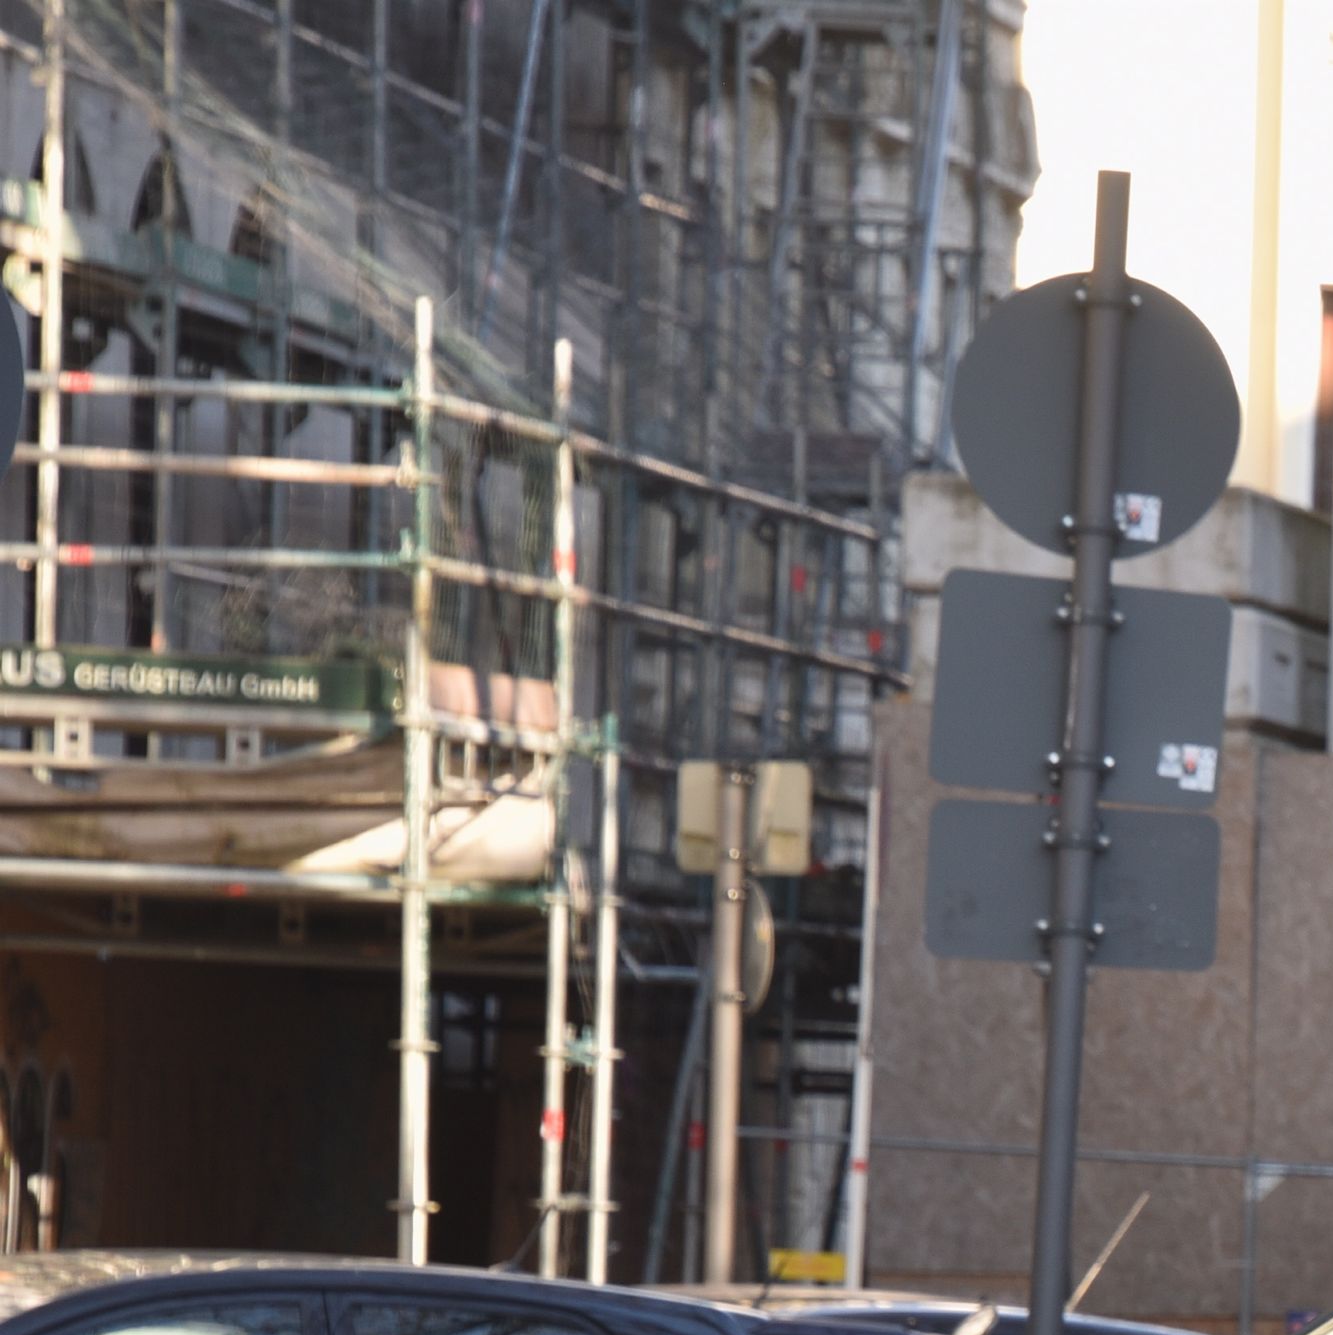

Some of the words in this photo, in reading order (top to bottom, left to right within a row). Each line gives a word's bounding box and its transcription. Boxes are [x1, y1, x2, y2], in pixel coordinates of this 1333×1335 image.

[0, 649, 67, 688] US
[73, 662, 237, 698] GERÜSTBAU
[240, 673, 320, 703] GmbH
